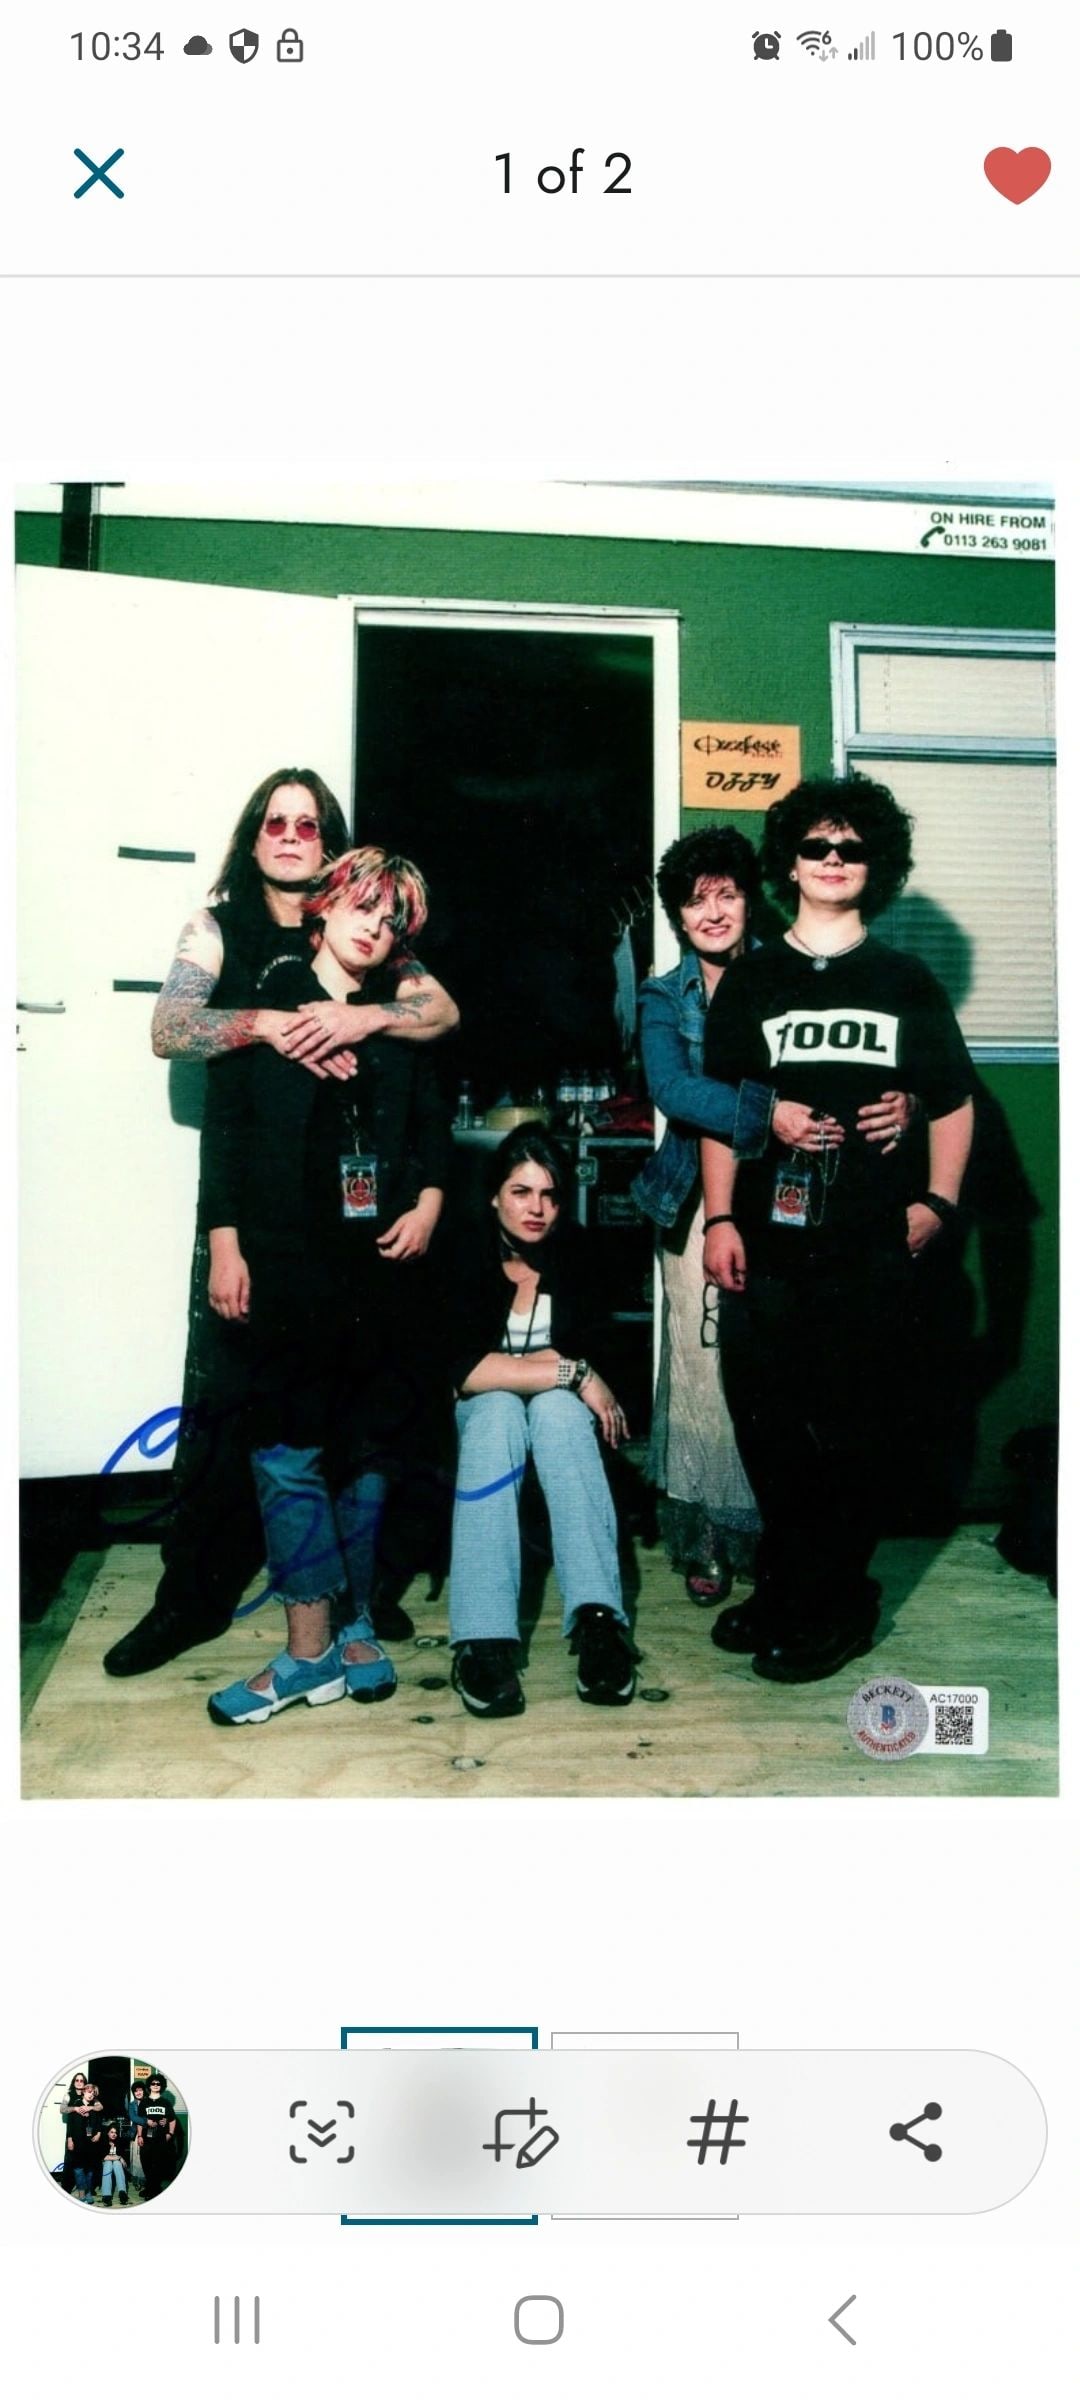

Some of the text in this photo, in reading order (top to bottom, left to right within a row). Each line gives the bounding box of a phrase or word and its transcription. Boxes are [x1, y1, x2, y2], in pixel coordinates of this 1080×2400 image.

[70, 31, 165, 61] 10:34
[892, 31, 984, 61] 100%
[495, 147, 632, 194] 1 of 2
[930, 511, 1046, 529] ON HIRE FROM
[944, 534, 1047, 551] 0113 263 9081
[861, 1684, 915, 1704] BECKETT
[857, 1729, 917, 1753] AUTHENTICATED
